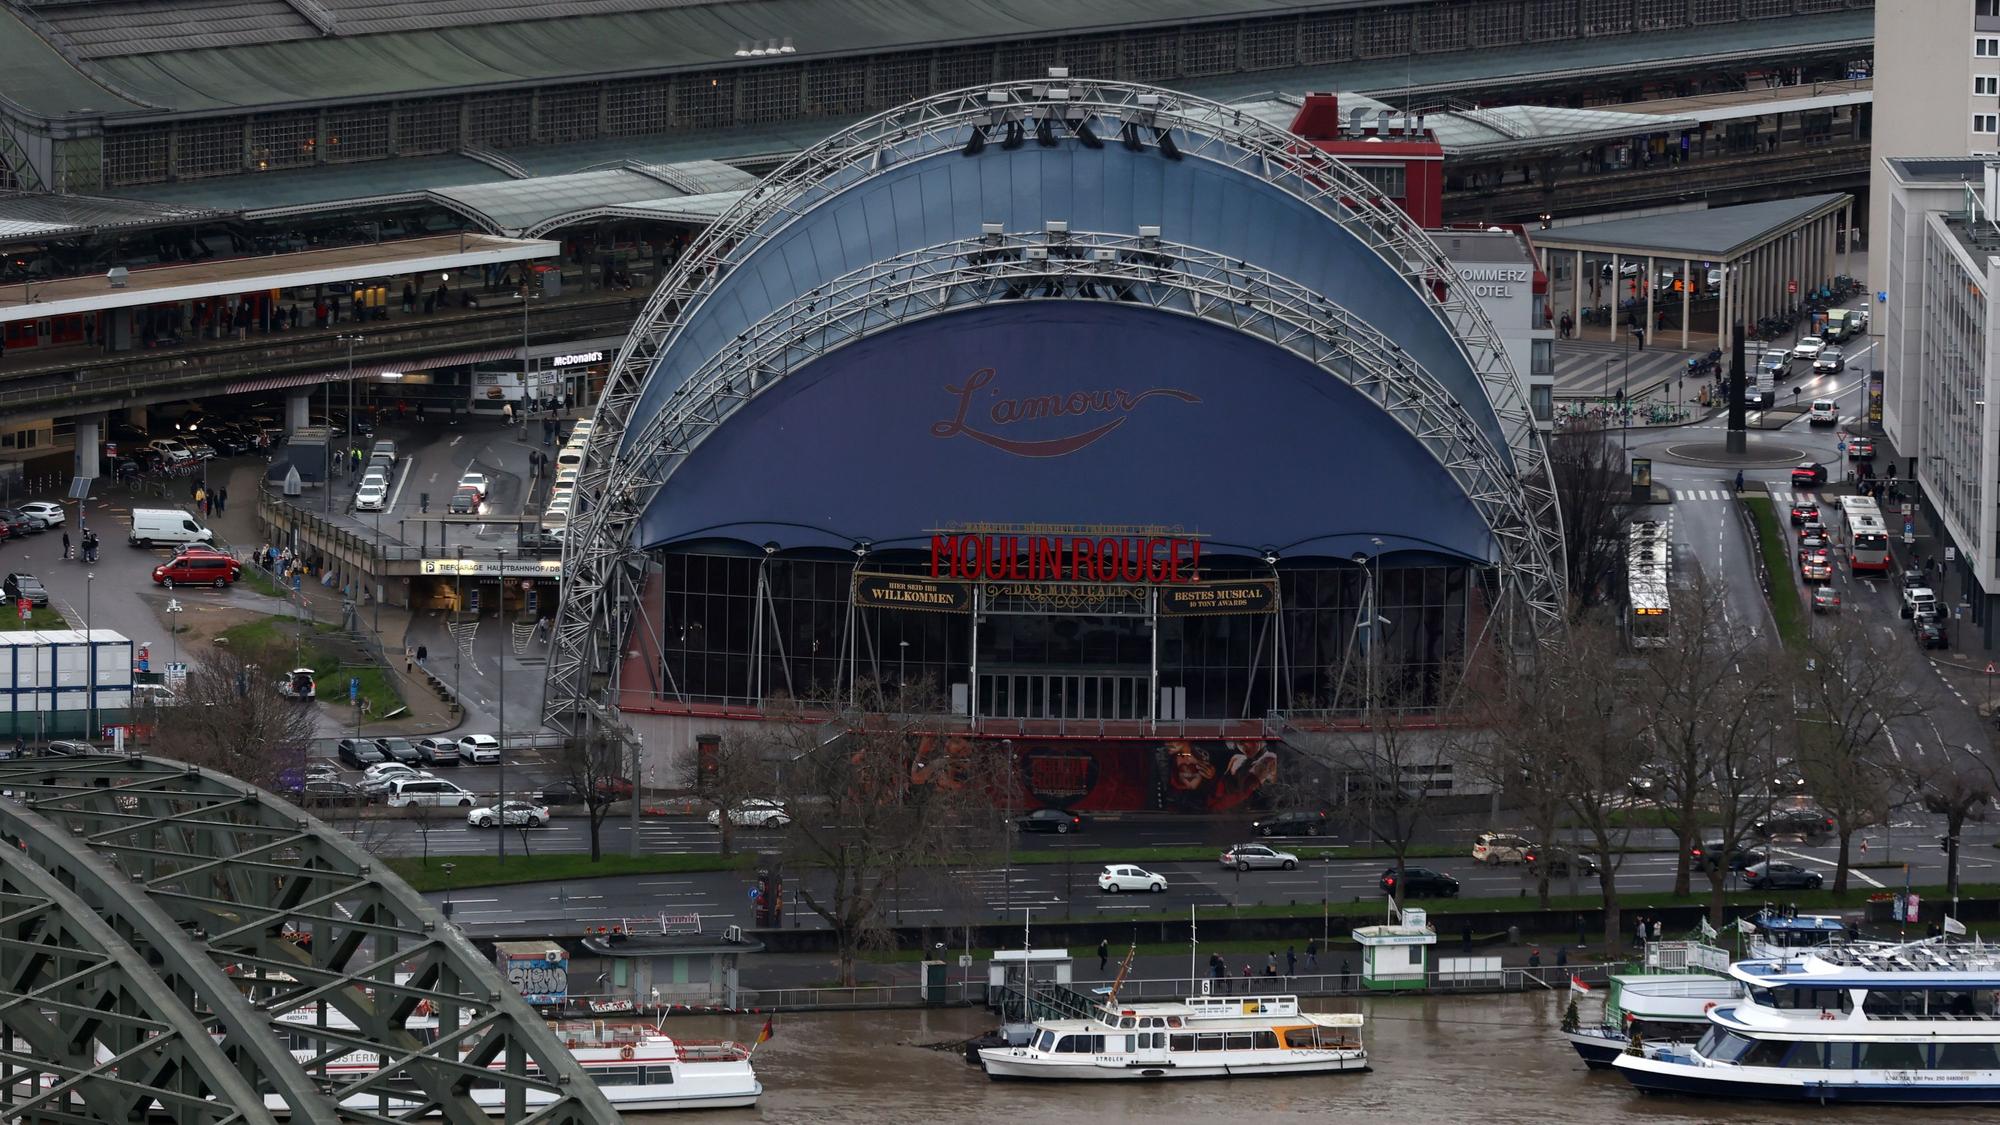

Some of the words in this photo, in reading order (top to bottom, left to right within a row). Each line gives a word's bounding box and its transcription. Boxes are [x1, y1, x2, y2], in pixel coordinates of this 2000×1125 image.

[1458, 268, 1528, 282] OMMERZ
[553, 352, 603, 367] McDonald's
[929, 366, 1203, 458] L'amour
[931, 535, 1064, 581] MOULIN
[1071, 536, 1201, 584] ROUGE!
[889, 582, 906, 590] HIER
[907, 583, 923, 591] SEID
[925, 584, 937, 592] IHR
[1015, 584, 1040, 595] DAS
[872, 588, 955, 604] WILLKOMMEN
[1175, 591, 1215, 601] BESTES
[1216, 589, 1263, 600] MUSICAL
[334, 1053, 380, 1063] STERM
